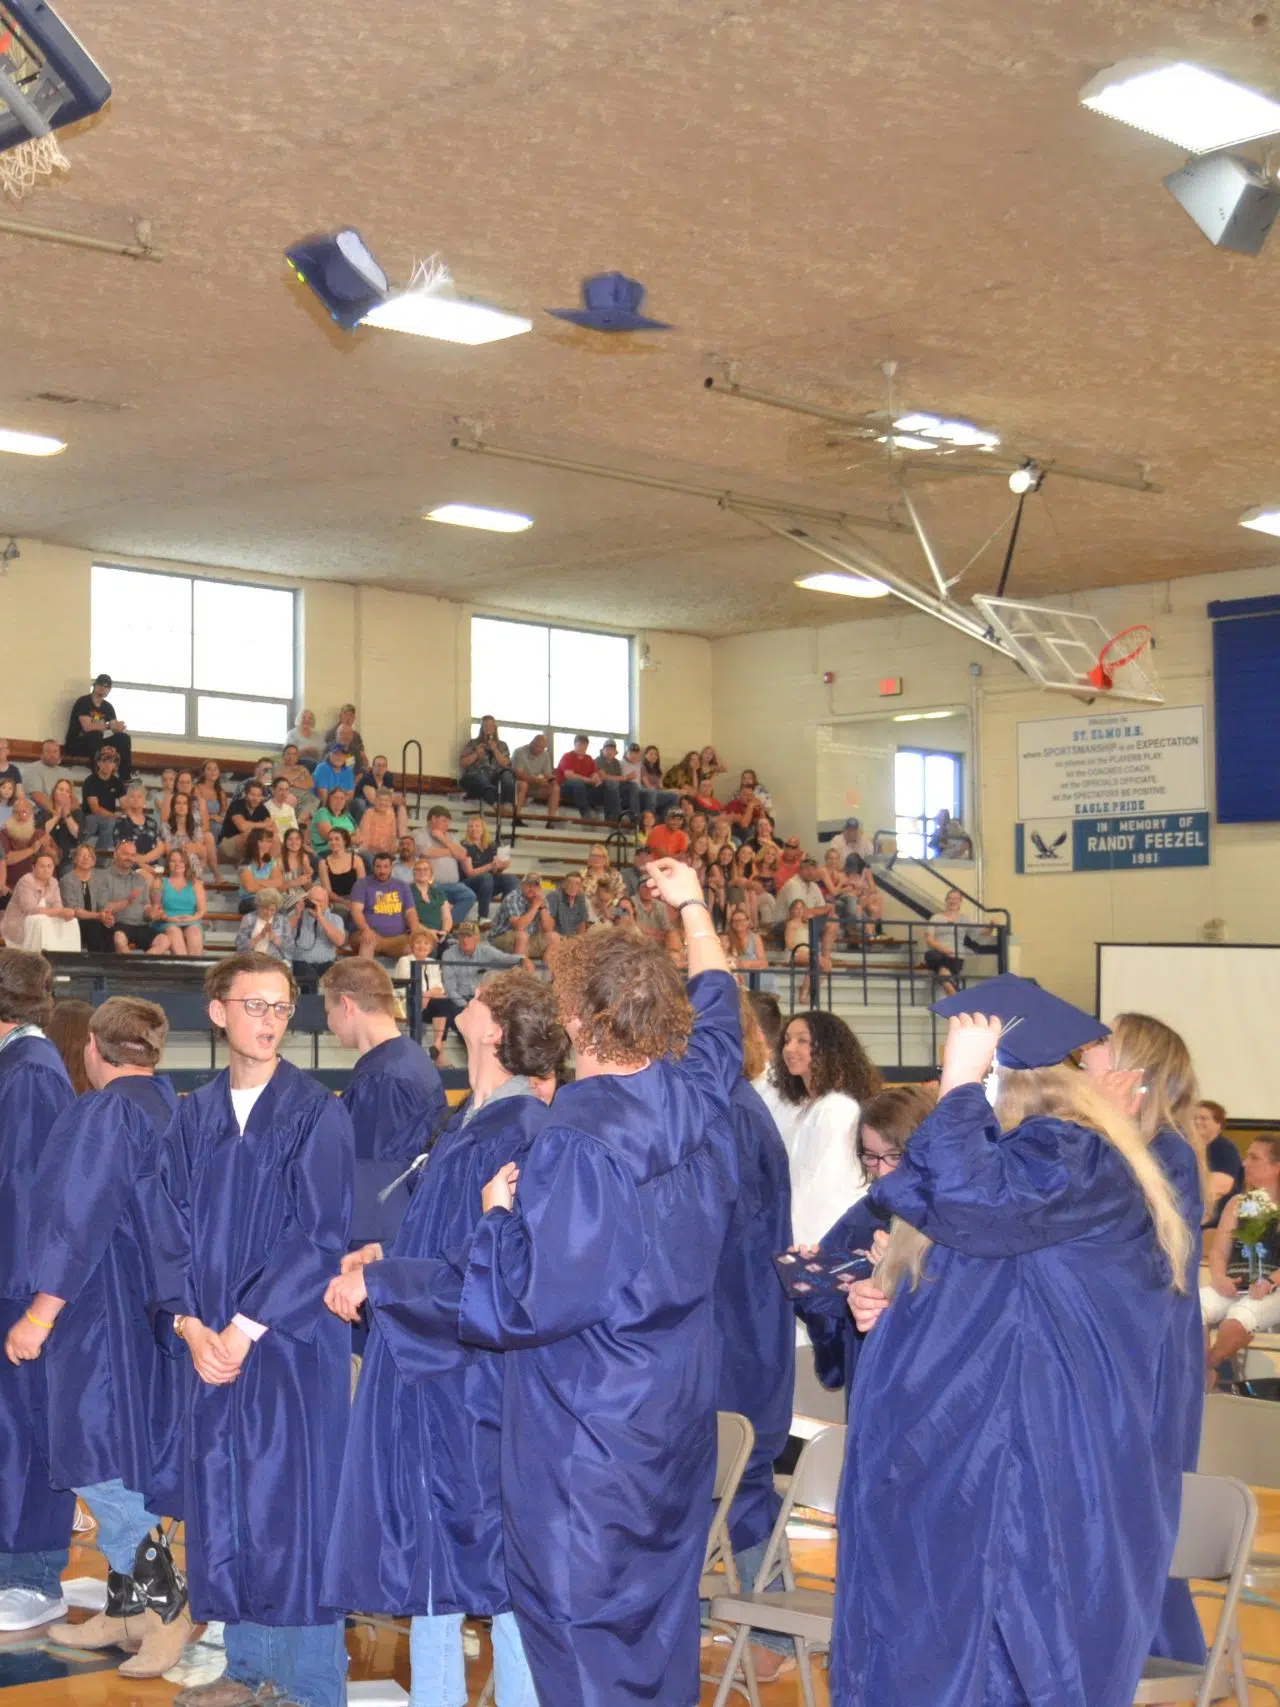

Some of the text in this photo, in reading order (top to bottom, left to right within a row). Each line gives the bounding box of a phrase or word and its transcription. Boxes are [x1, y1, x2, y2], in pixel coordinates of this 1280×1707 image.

[1072, 730, 1088, 741] ST.
[1092, 728, 1121, 740] ELMO
[1043, 743, 1117, 757] SPORTSMANSHIP
[1136, 736, 1199, 750] EXPECTATION
[1073, 789, 1119, 800] SPECTATORS
[1075, 800, 1144, 814] EAGLE PRIDE
[1096, 817, 1193, 833] IN MEMORY OF
[1087, 832, 1205, 852] RANDY FEEZEL
